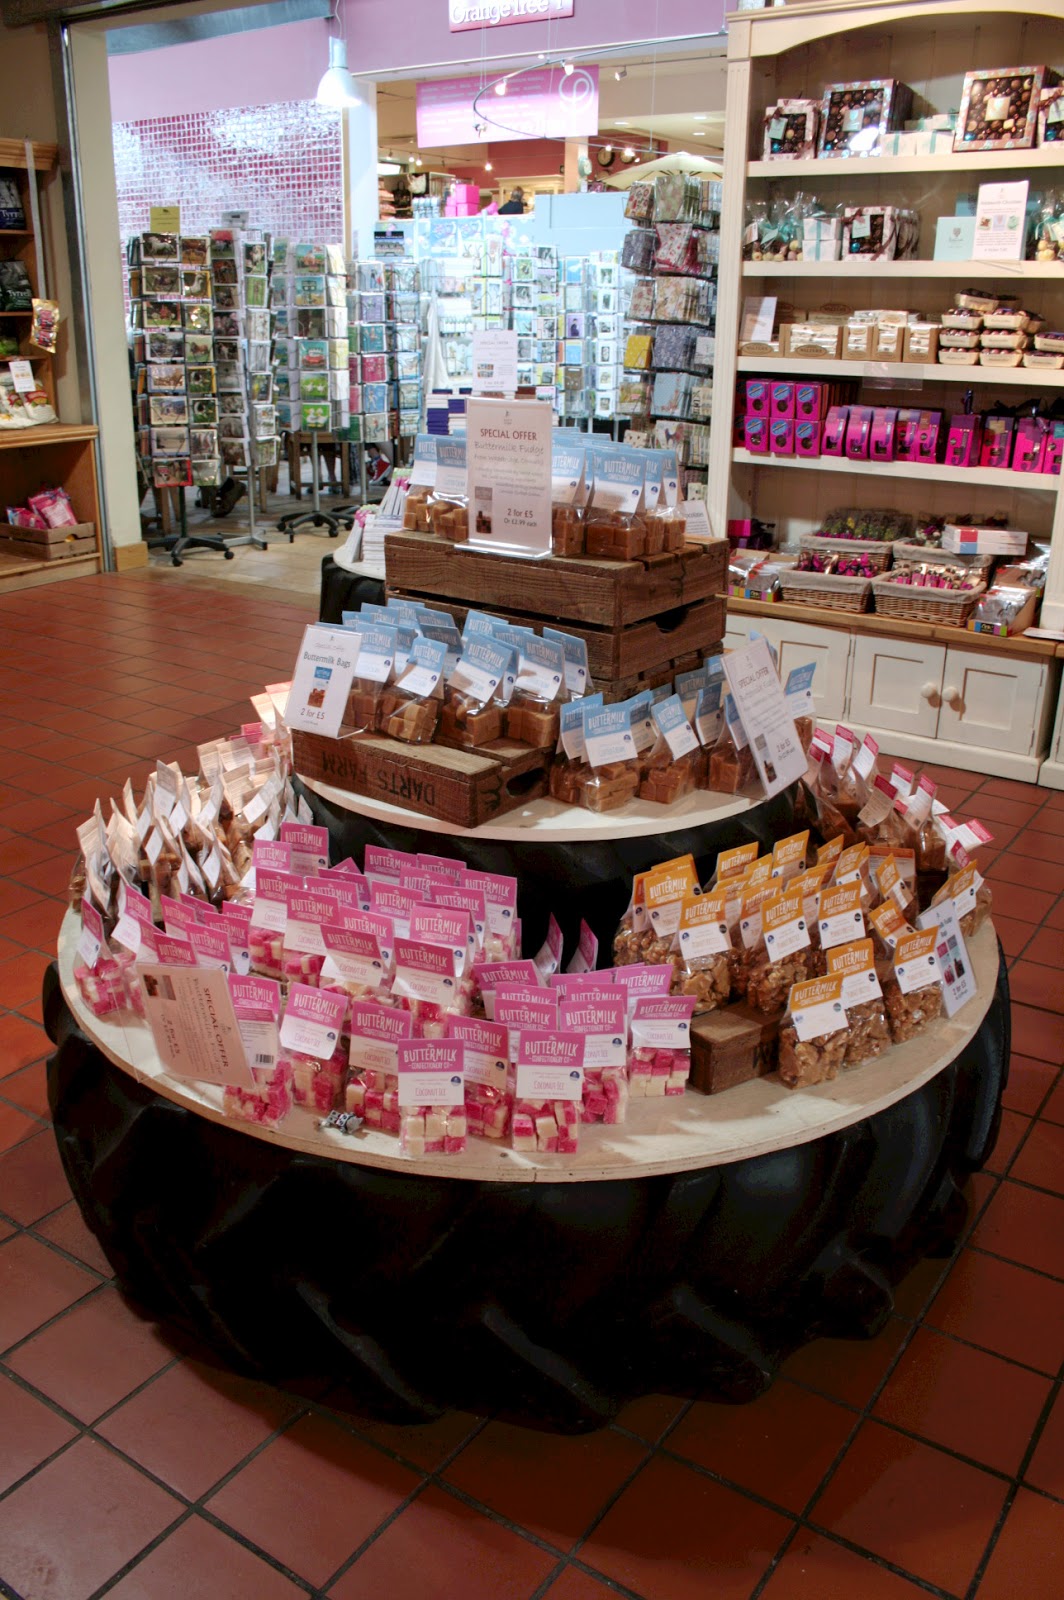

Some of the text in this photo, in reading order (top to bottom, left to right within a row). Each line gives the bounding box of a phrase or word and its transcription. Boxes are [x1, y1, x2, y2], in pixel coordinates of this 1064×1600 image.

[480, 428, 538, 441] SPECIAL OFFER
[474, 441, 544, 457] Buttermilk Fudge
[603, 460, 641, 476] BUTTERMILK
[507, 508, 534, 518] 2 for £5
[303, 651, 351, 668] Buttermilk Bags
[468, 643, 504, 668] BUTTERMILK
[300, 708, 325, 720] 2 for £5
[588, 711, 625, 730] BUTTERMILK
[321, 751, 436, 806] DARTS FARM
[285, 831, 323, 848] BUTTERMILK
[257, 847, 287, 862] BUTTERMILK
[465, 879, 511, 898] BUTTERMILK
[650, 876, 688, 899] BUTTERMILK
[291, 898, 334, 917] BUTTERMILK
[435, 894, 479, 911] BUTTERMILK
[823, 889, 857, 911] BUTTERMILK
[686, 900, 722, 920] BUTTERMILK
[766, 897, 799, 923] BUTTERMILK
[344, 917, 387, 937] BUTTERMILK
[415, 917, 462, 938] BUTTERMILK
[190, 932, 225, 952] BUTTERMILK
[327, 933, 374, 950] BUTTERMILK
[900, 936, 933, 956] BUTTERMILK
[158, 942, 191, 961] BUTTERMILK
[400, 948, 448, 967] BUTTERMILK
[833, 949, 869, 971] BUTTERMILK
[482, 970, 529, 981] BUTTERMILK
[621, 974, 666, 988] BUTTERMILK
[233, 984, 274, 1003] BUTTERMILK
[795, 980, 838, 1001] BUTTERMILK
[294, 993, 340, 1018] BUTTERMILK
[640, 1003, 689, 1015] BUTTERMILK
[203, 987, 229, 1068] SPECIAL OFFER
[357, 1012, 404, 1035] BUTTERMILK
[499, 1010, 550, 1026] BUTTERMILK
[566, 1010, 617, 1026] BUTTERMILK
[454, 1026, 502, 1047] BUTTERMILK
[404, 1048, 457, 1063] BUTTERMILK
[525, 1040, 579, 1057] BUTTERMILK
